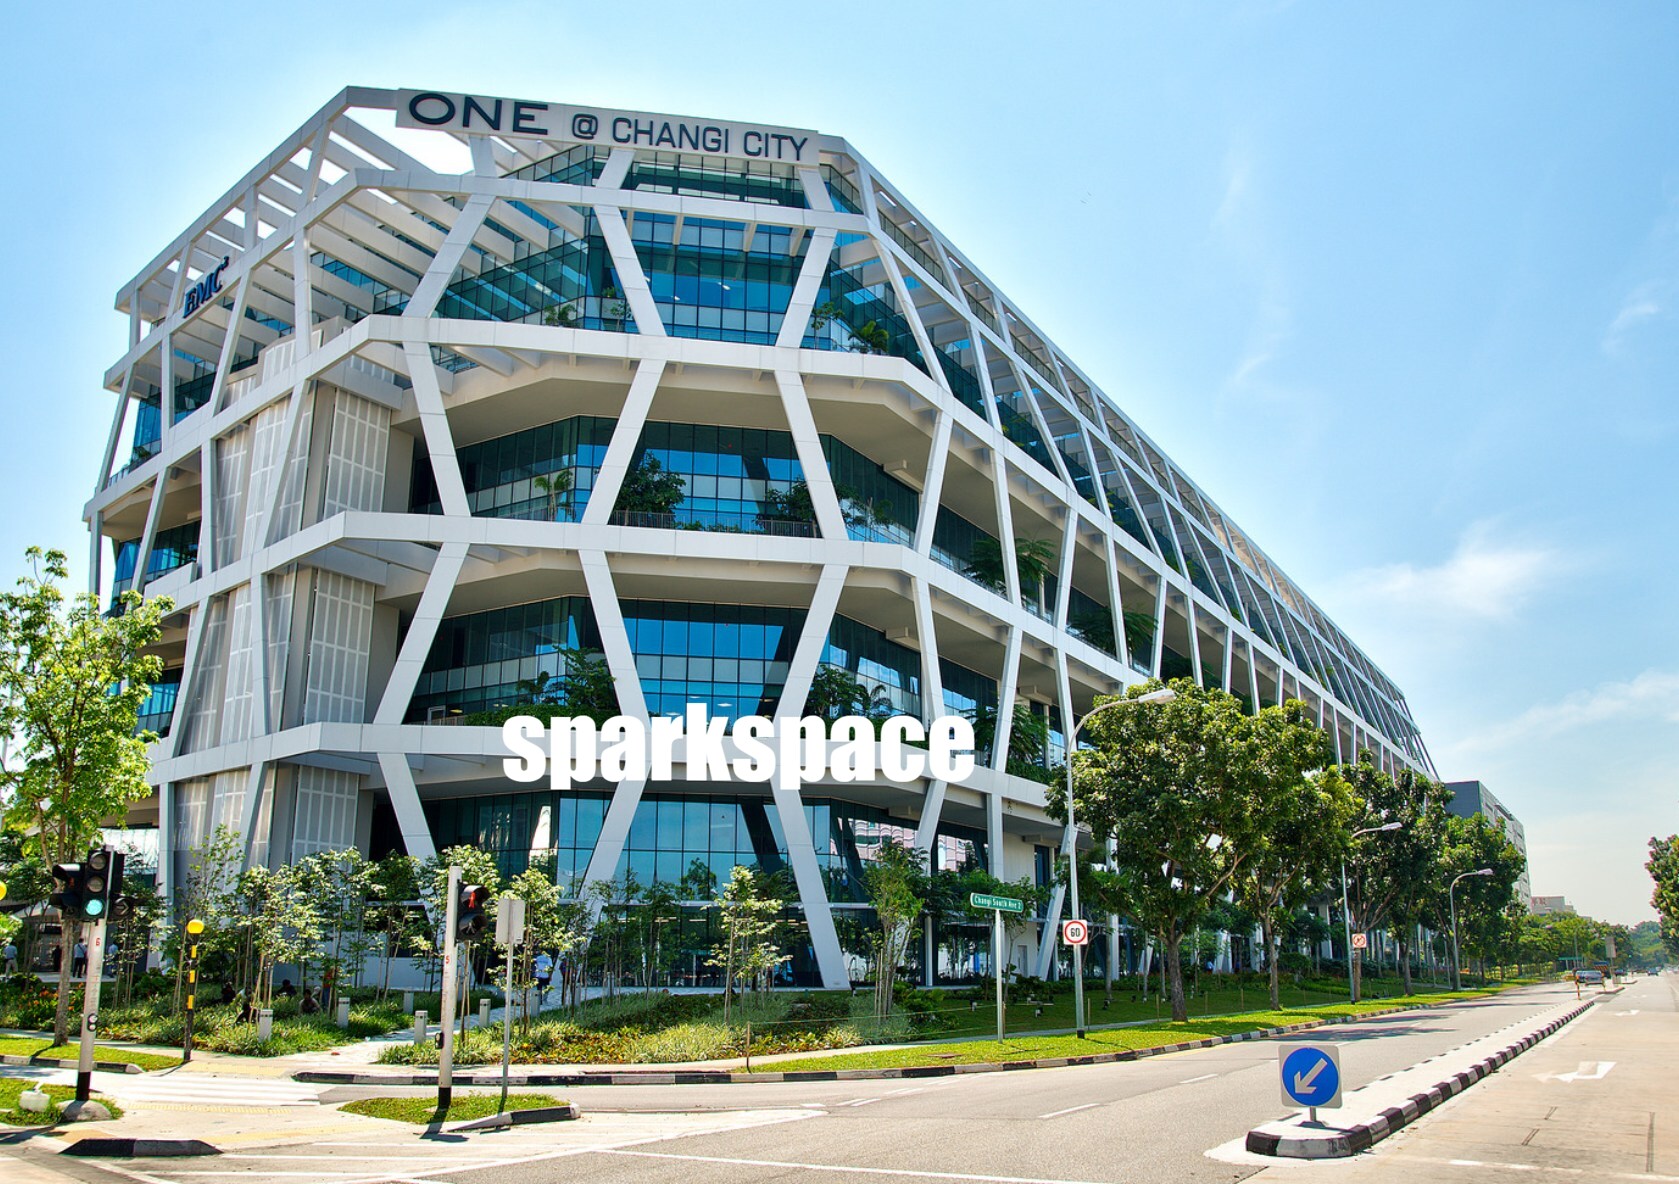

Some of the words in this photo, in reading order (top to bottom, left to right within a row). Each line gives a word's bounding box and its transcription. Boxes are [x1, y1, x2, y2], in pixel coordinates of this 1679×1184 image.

[409, 93, 548, 135] ONE
[572, 113, 598, 140] @
[612, 117, 729, 153] CHANGI
[744, 131, 808, 161] CITY
[974, 894, 991, 907] Changi
[992, 898, 1007, 907] South
[1070, 927, 1081, 938] 60
